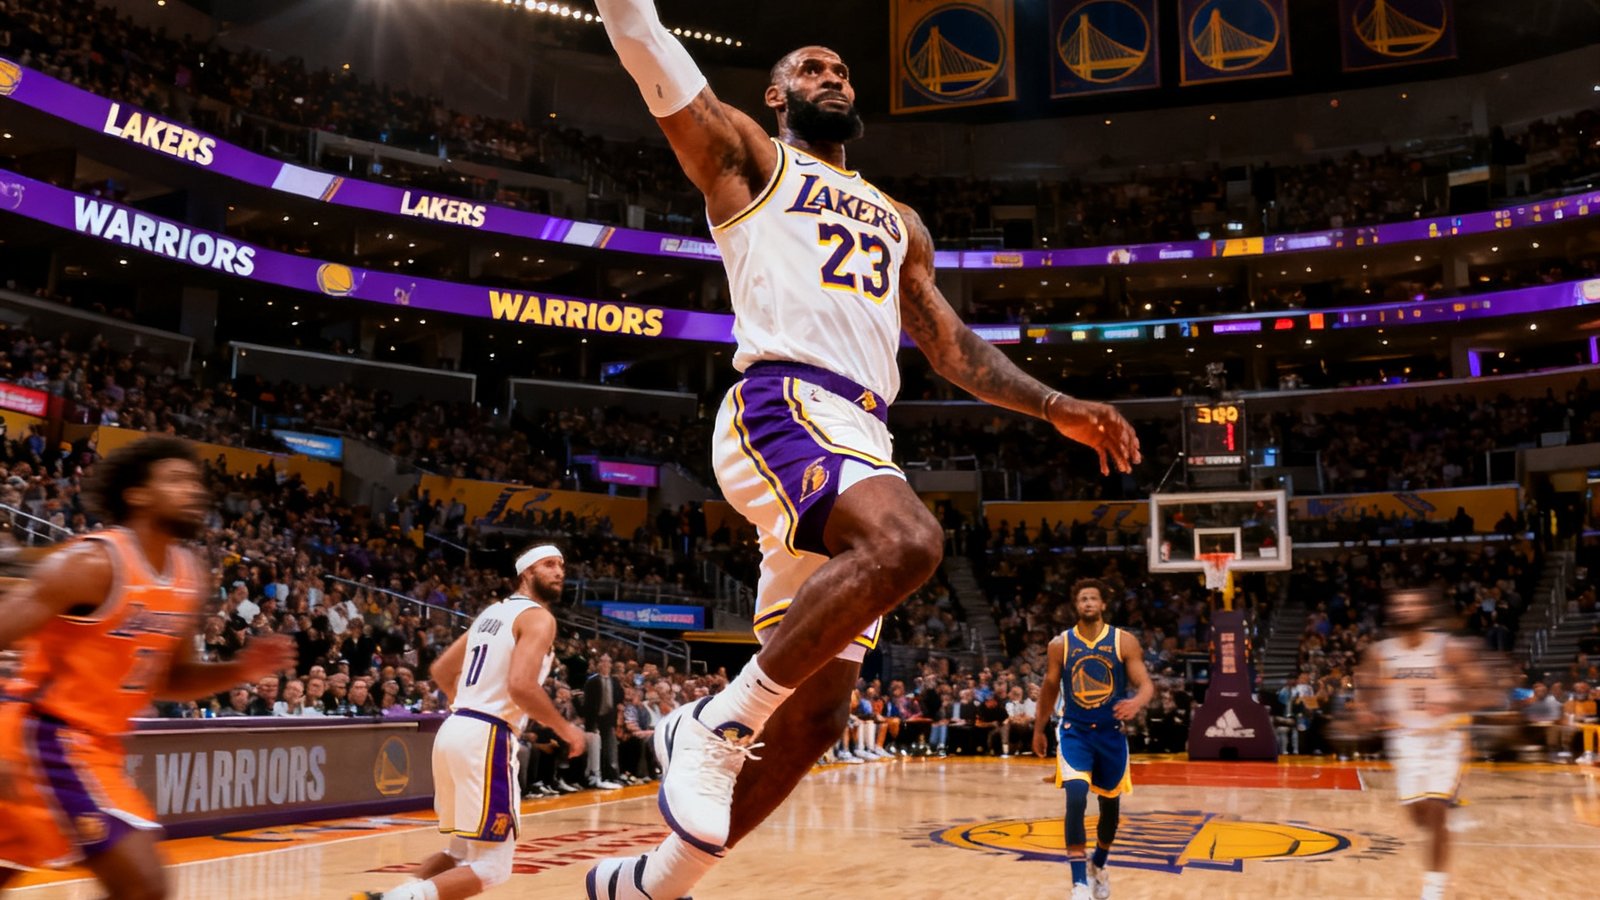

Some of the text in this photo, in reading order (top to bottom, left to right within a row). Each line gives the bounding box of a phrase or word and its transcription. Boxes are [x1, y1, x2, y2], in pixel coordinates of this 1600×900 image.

[103, 103, 217, 166] LAKERS
[74, 195, 256, 278] WARRIORS
[400, 191, 487, 228] LAKERS
[784, 173, 901, 243] LAKERS
[817, 222, 892, 305] 23
[488, 290, 664, 337] WARRIORS
[465, 643, 489, 688] 11
[156, 745, 327, 816] WARRIORS
